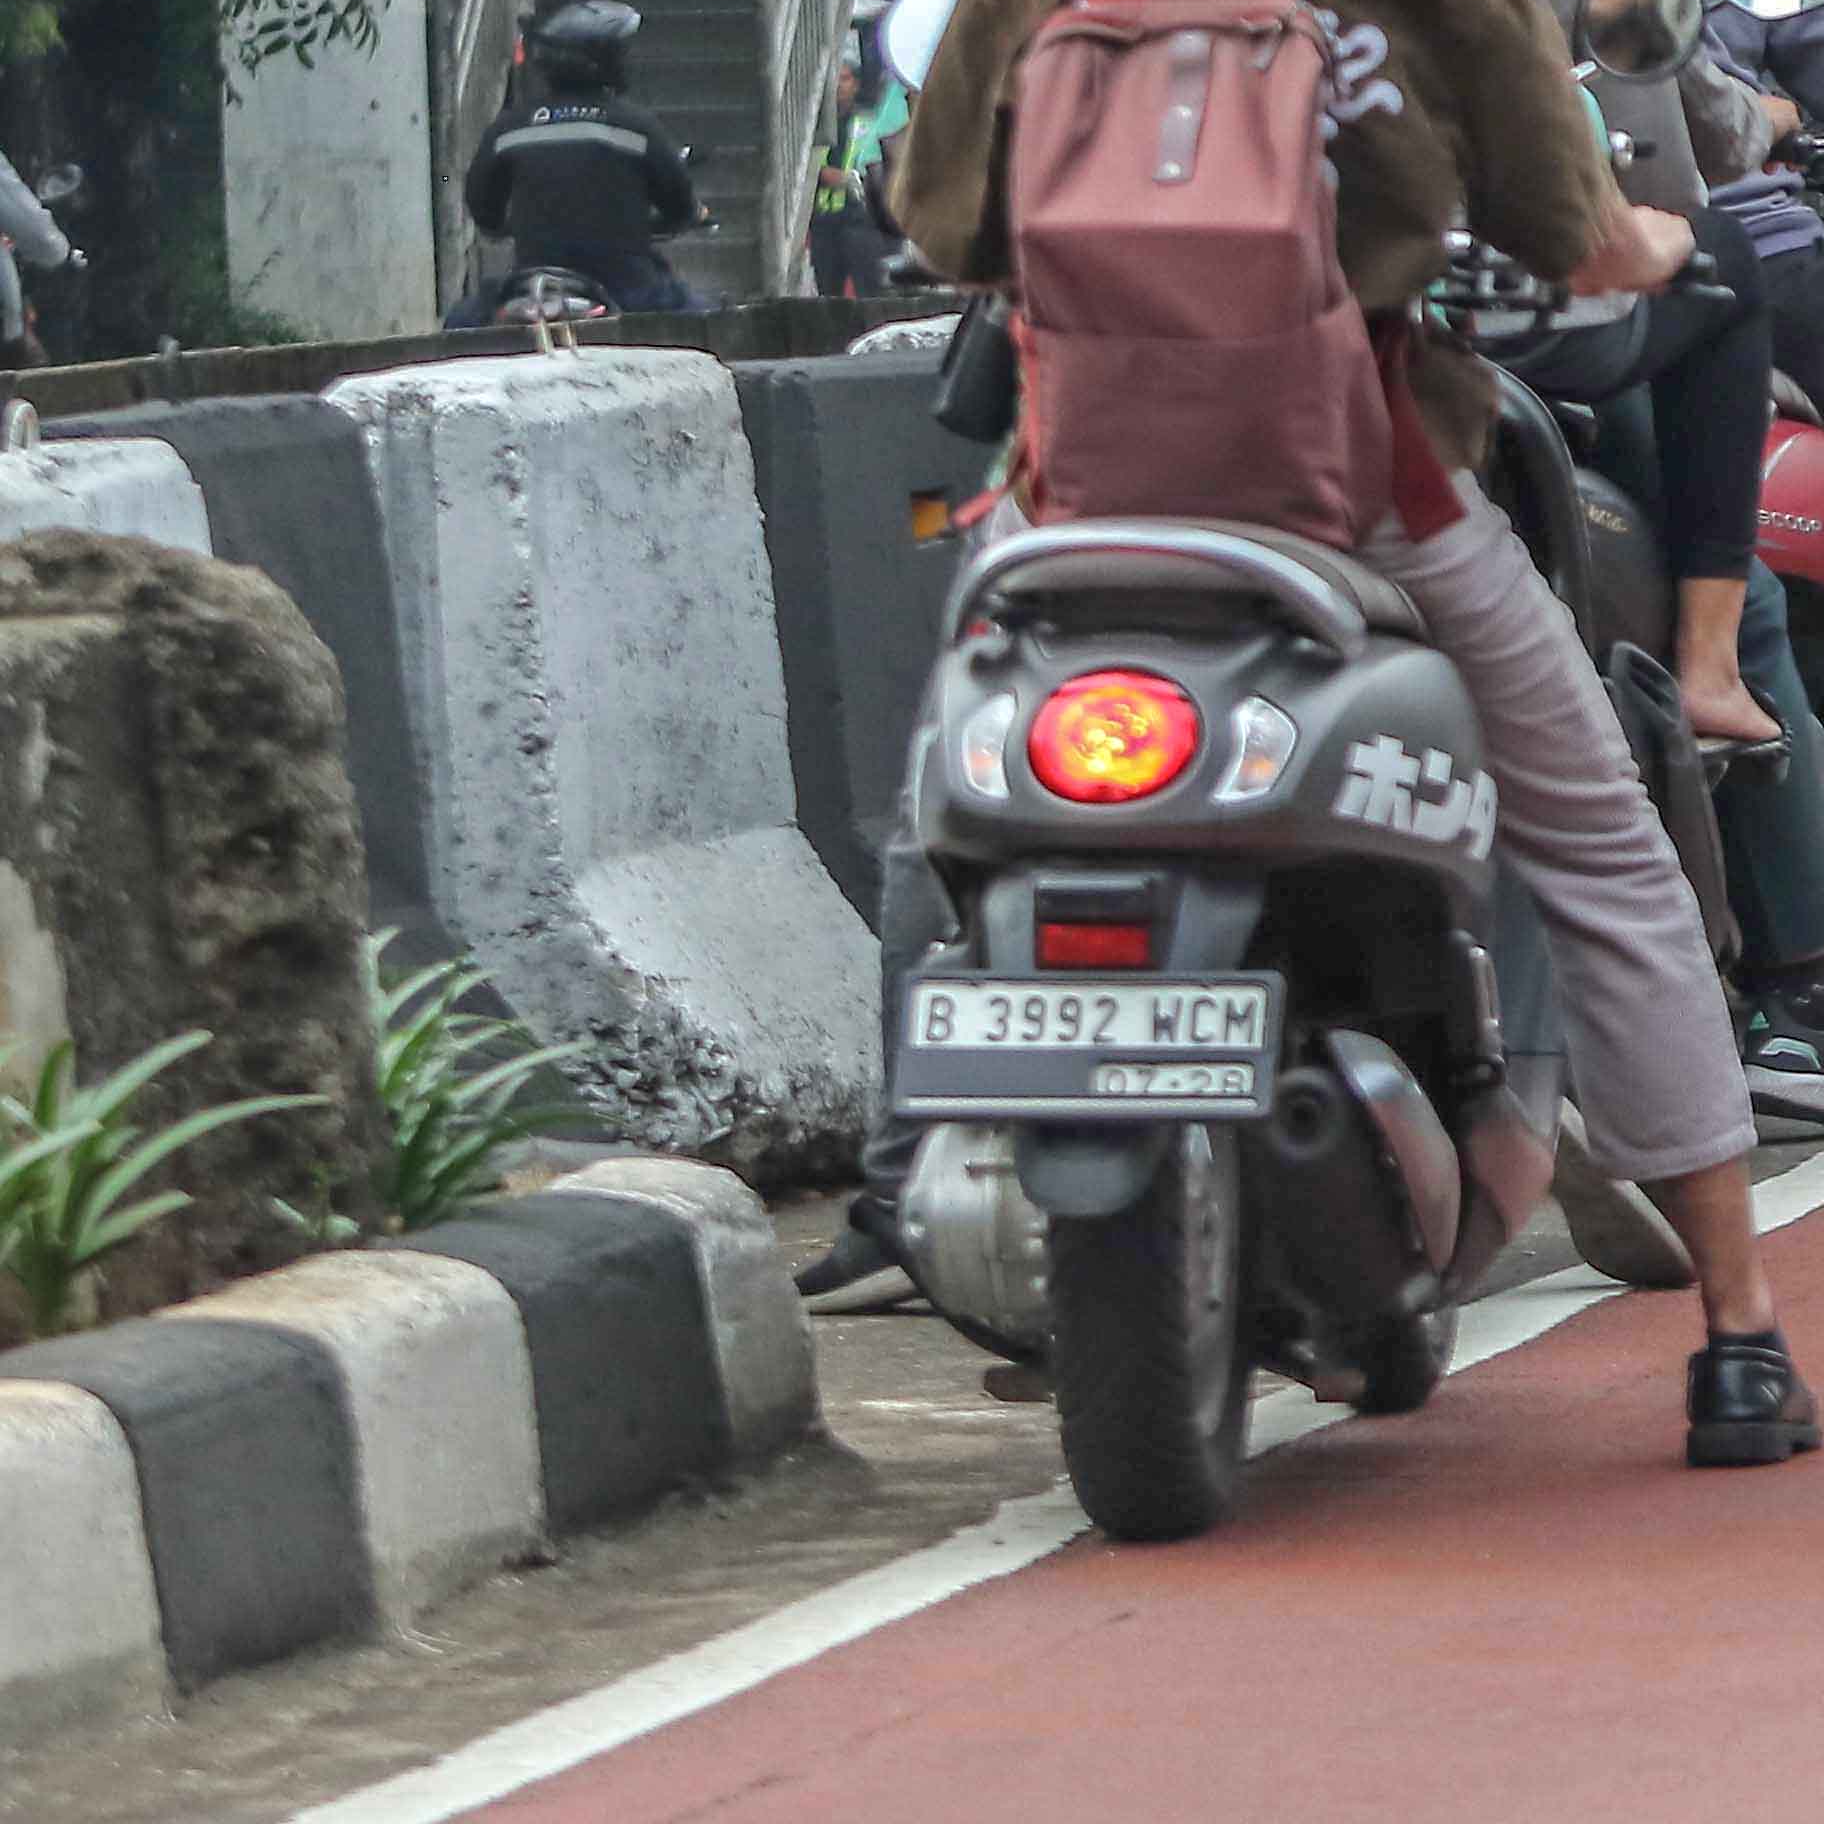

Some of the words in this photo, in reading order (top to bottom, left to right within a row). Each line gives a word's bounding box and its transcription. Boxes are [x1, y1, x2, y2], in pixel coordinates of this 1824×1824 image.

[926, 995, 953, 1042] B
[985, 995, 1120, 1044] 3992
[1152, 995, 1256, 1045] WCM
